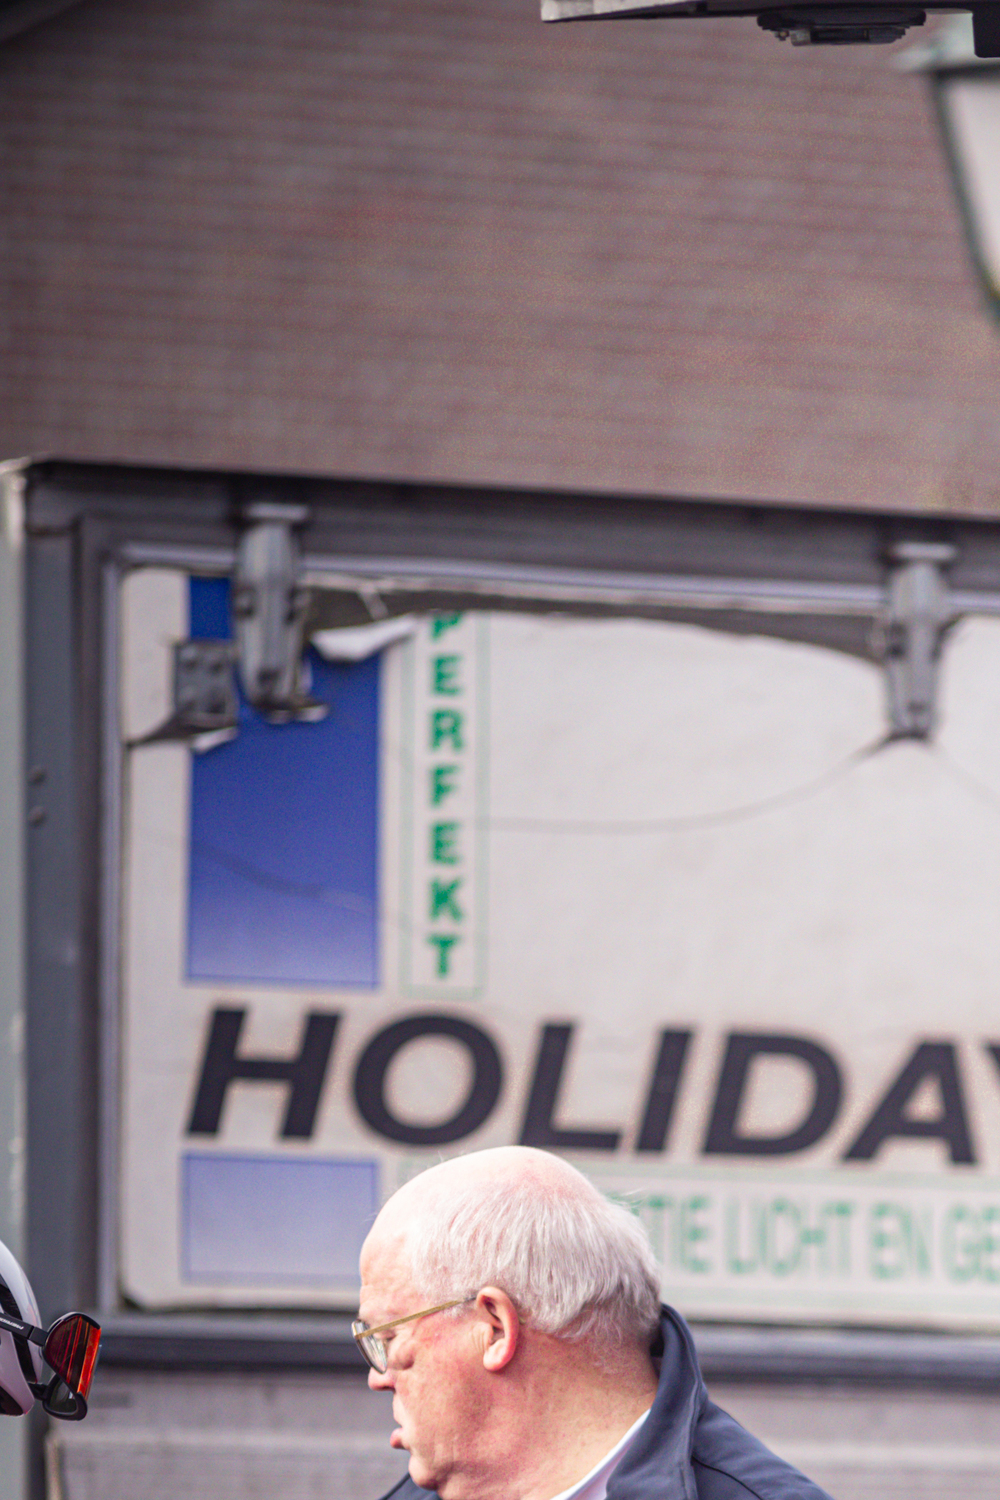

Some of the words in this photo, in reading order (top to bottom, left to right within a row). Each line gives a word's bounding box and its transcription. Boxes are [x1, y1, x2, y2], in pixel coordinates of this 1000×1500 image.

[427, 611, 464, 978] PERFEKT
[725, 1197, 855, 1276] LICHT
[872, 1202, 936, 1280] EN
